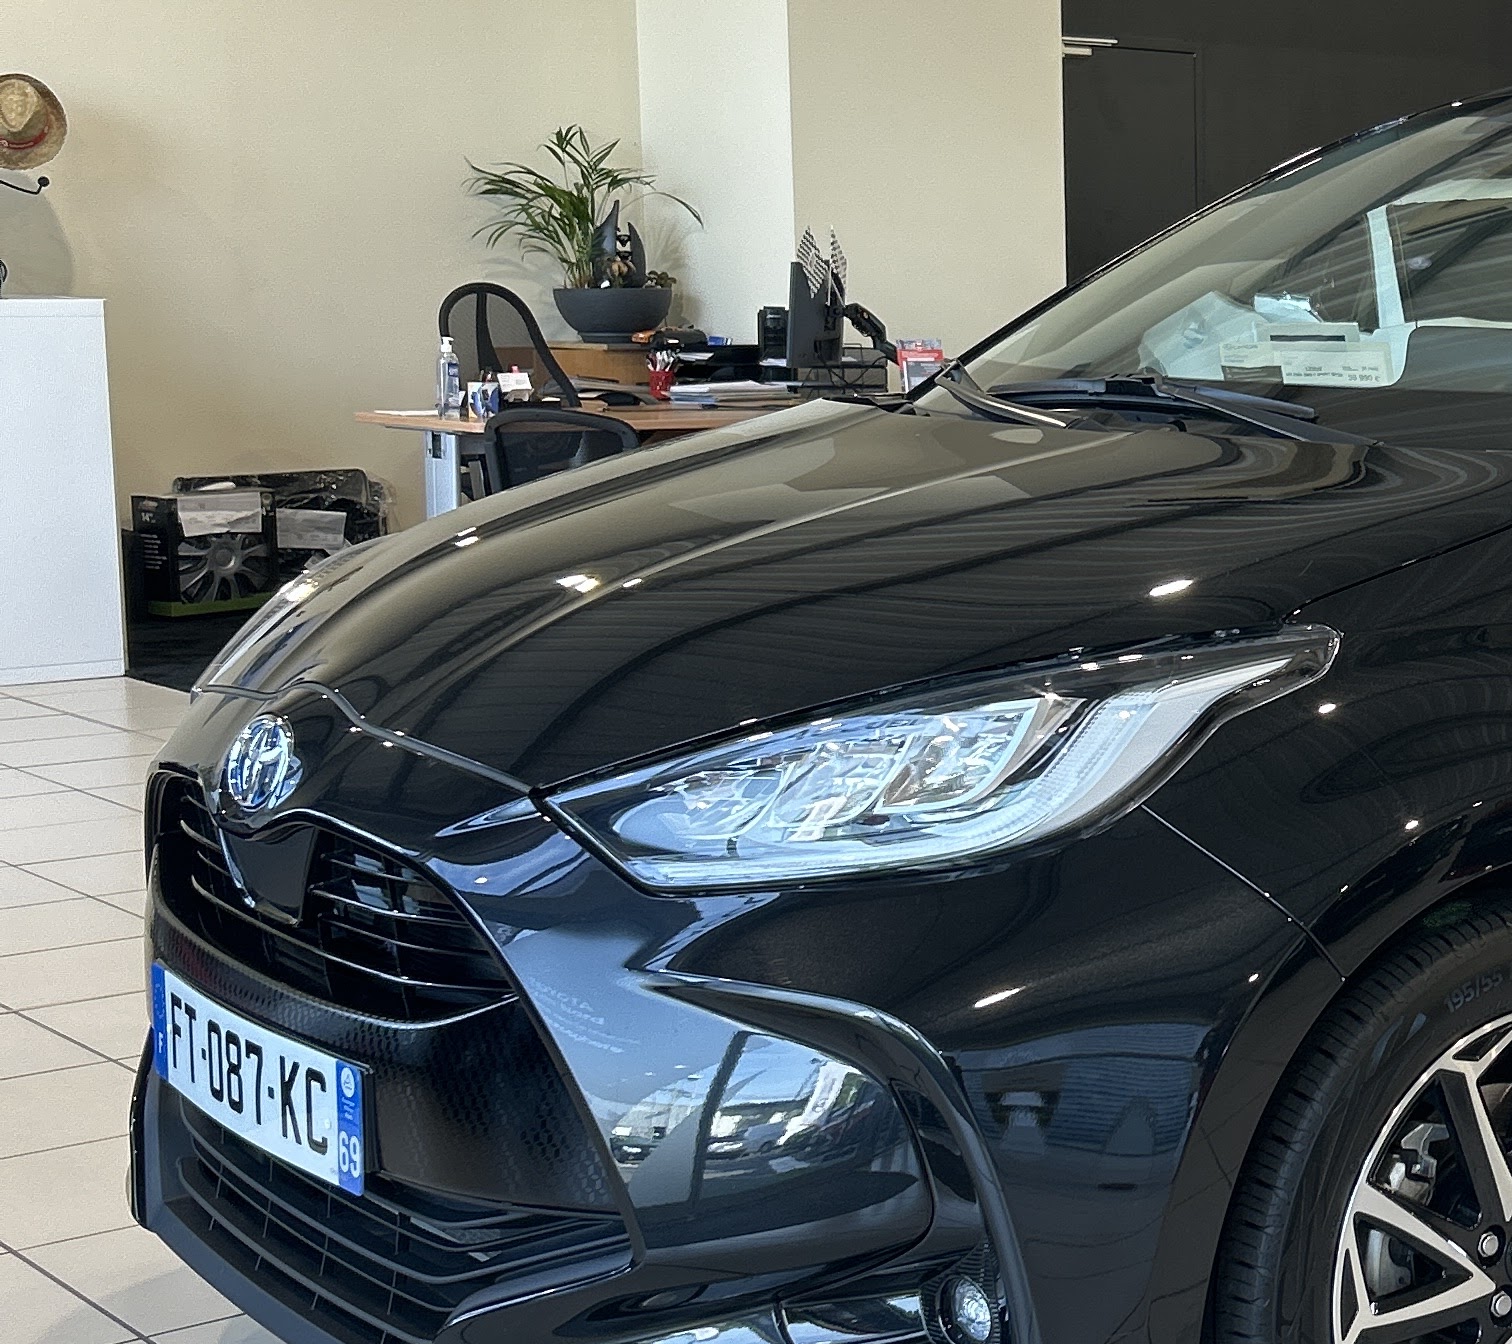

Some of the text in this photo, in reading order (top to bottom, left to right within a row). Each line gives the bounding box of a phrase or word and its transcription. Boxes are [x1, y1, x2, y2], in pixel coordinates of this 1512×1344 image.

[1444, 966, 1503, 1013] 195/55
[158, 1031, 164, 1054] F
[170, 992, 328, 1156] FT-087-KC
[338, 1130, 361, 1178] 69
